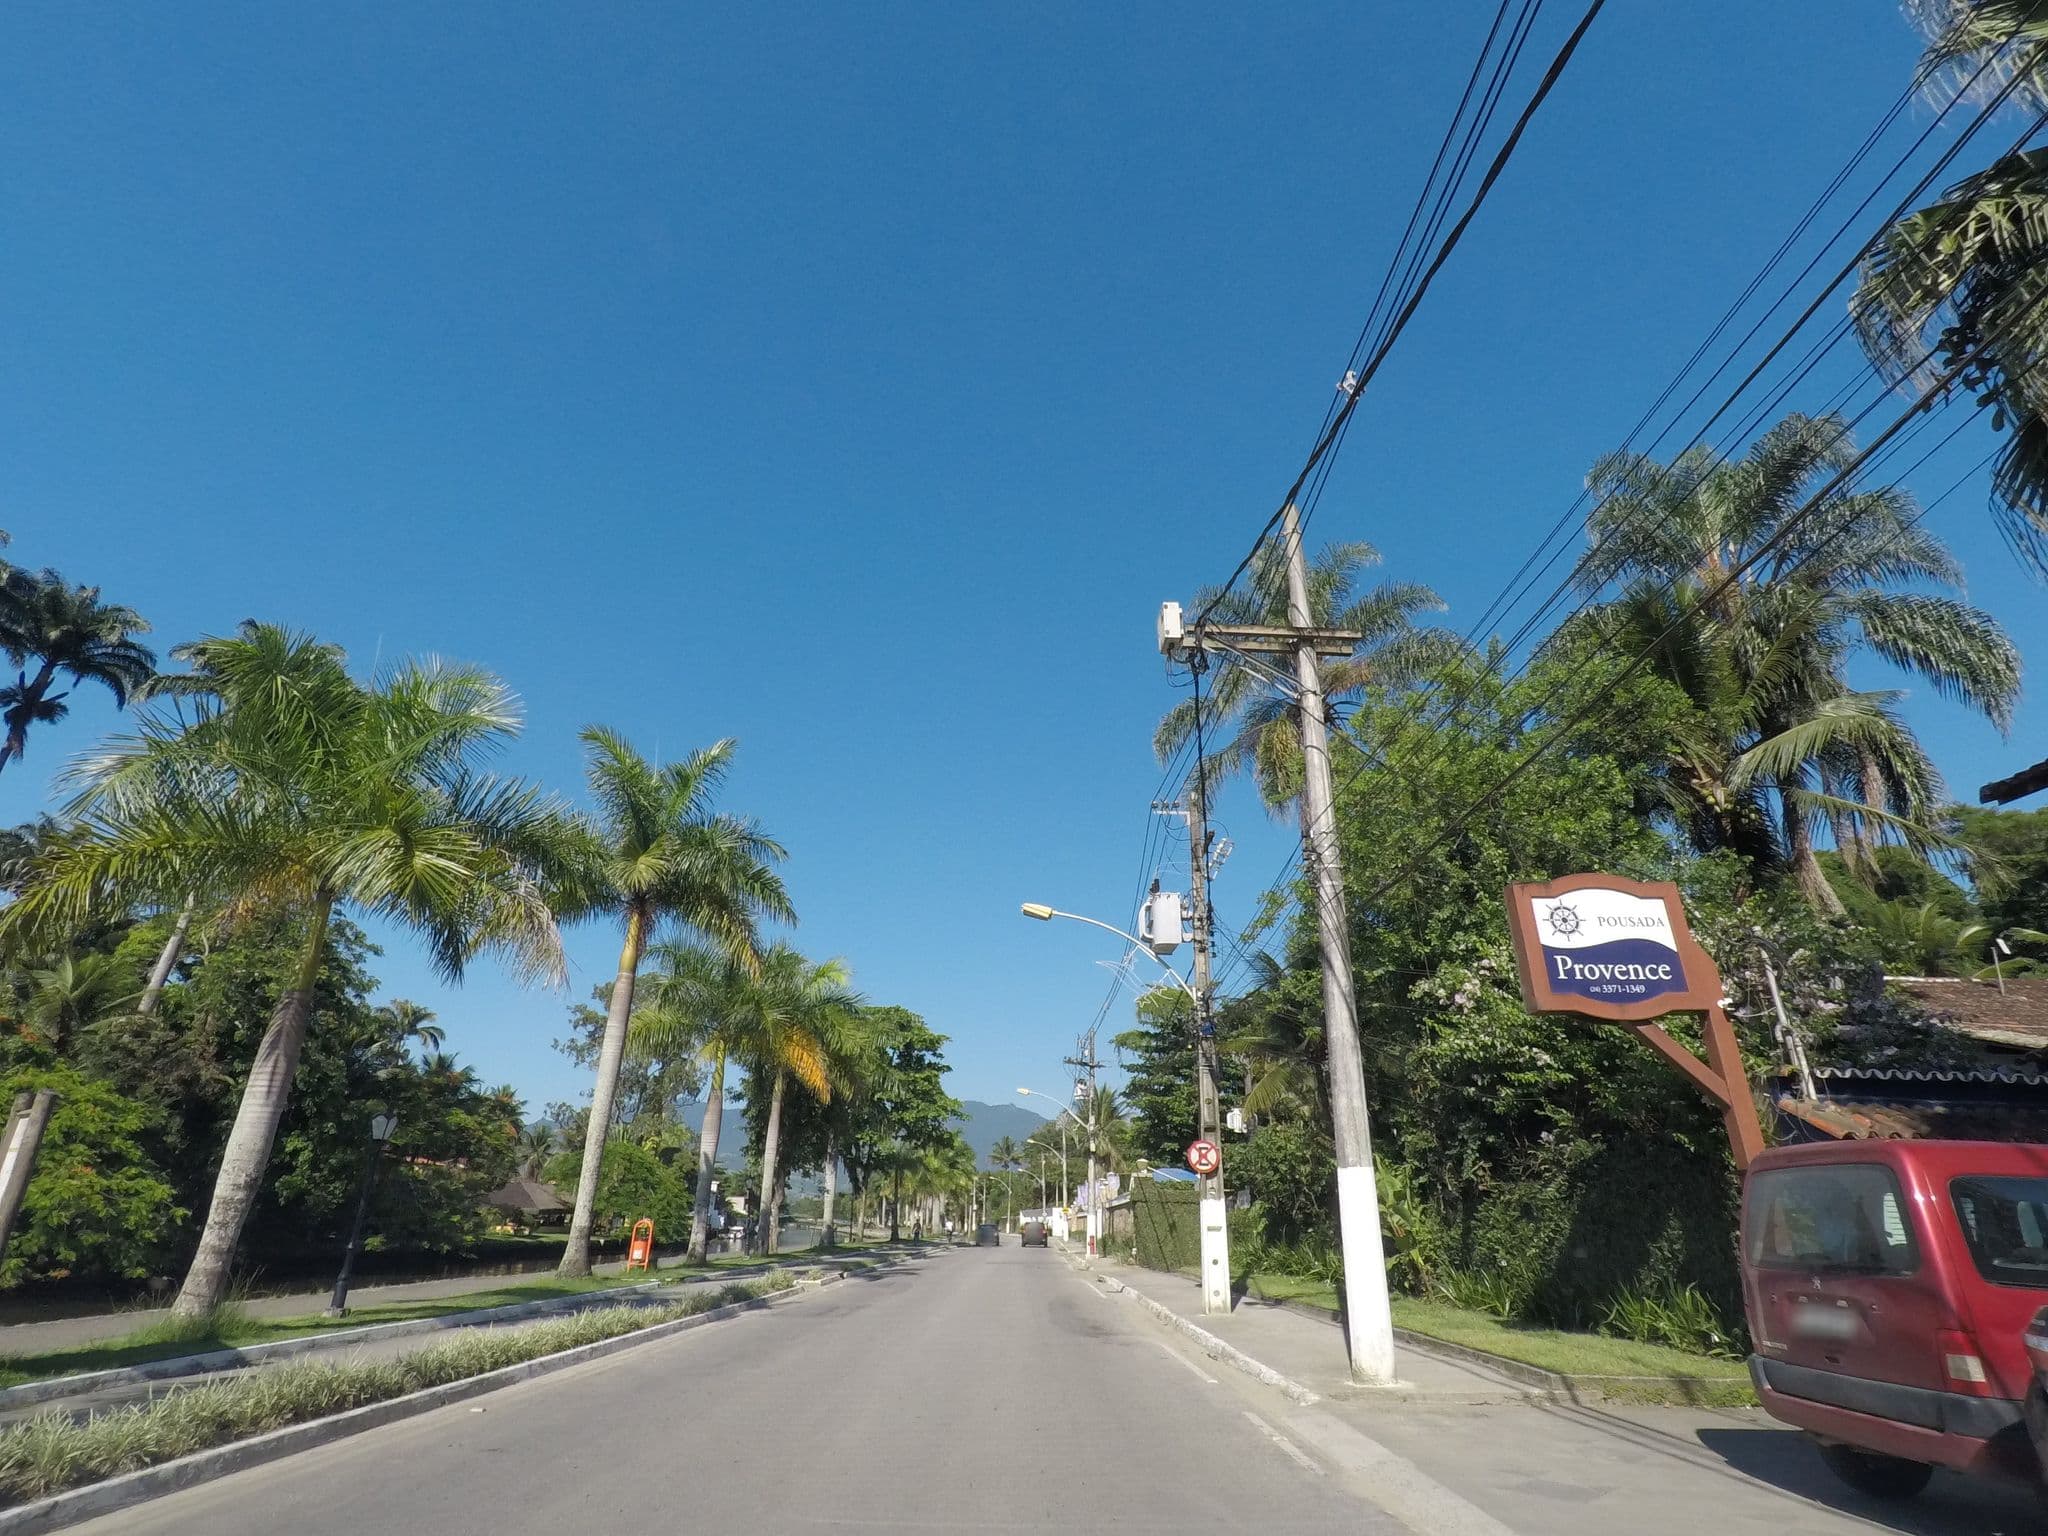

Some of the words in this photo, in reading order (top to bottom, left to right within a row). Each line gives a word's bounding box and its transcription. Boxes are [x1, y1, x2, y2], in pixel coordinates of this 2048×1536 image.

[1597, 916, 1665, 928] POUSADA
[1553, 954, 1673, 980] Provence
[1601, 984, 1646, 994] 3371-1349
